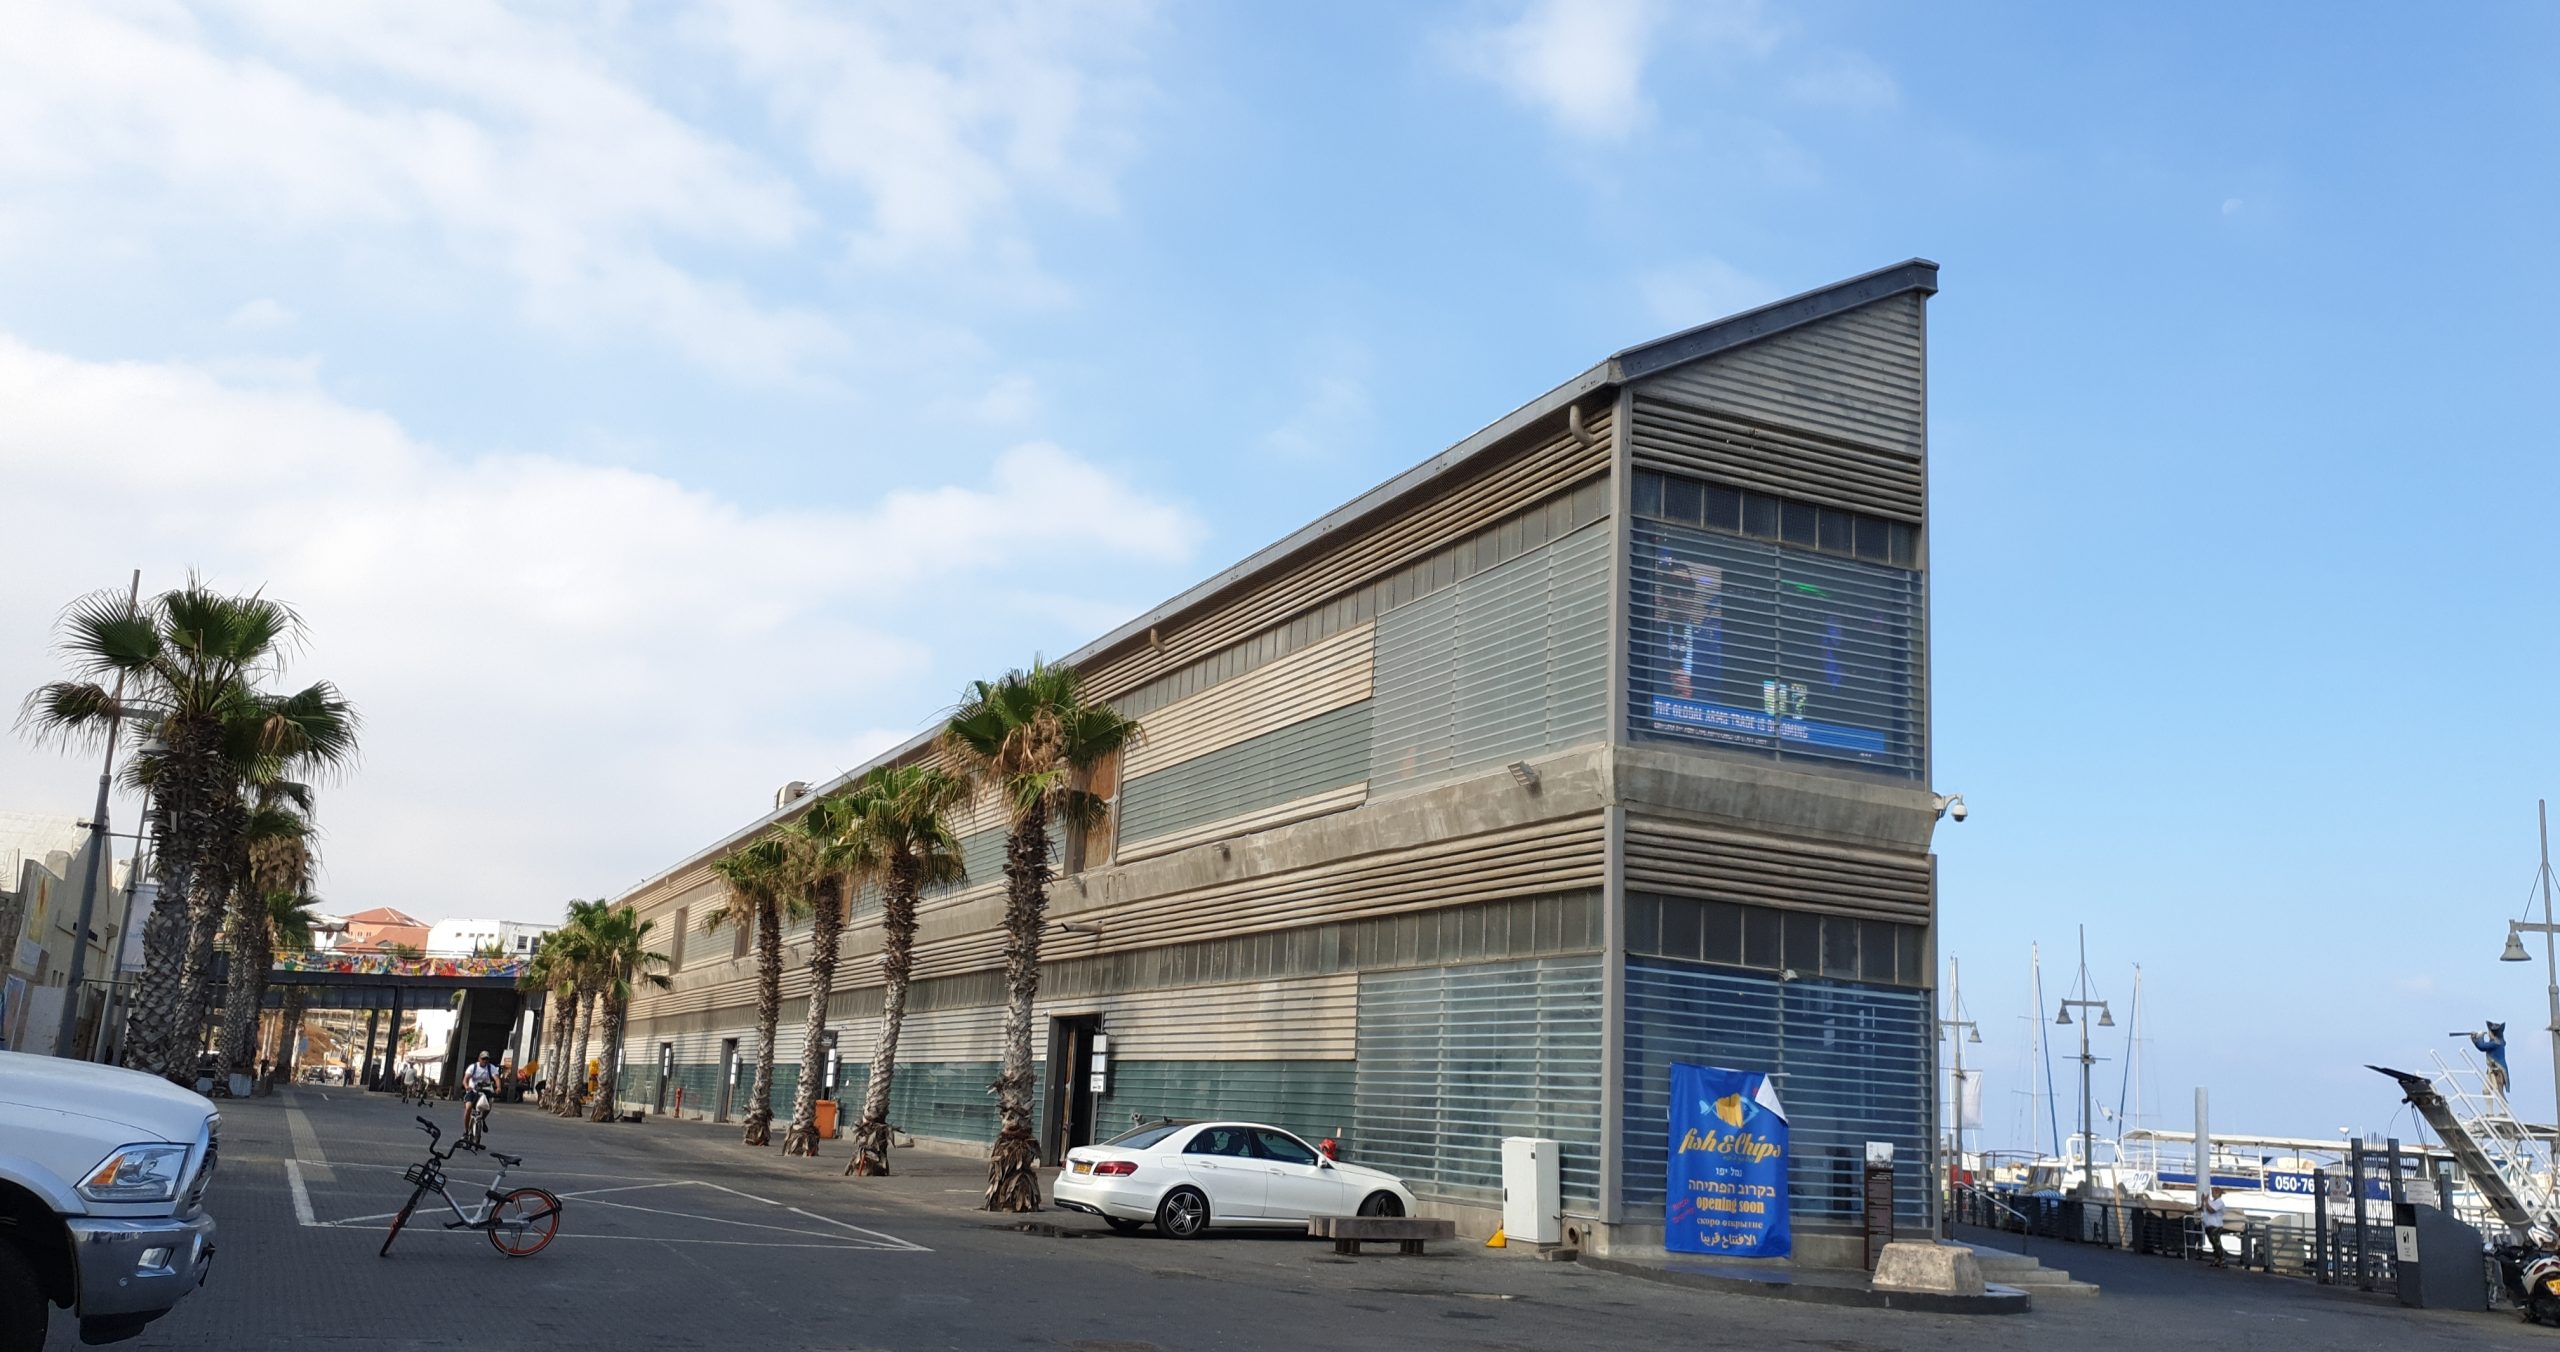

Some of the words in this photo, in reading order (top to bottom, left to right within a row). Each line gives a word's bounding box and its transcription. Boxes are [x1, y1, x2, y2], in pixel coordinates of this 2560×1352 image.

[1688, 1179, 1736, 1194] הפתיחה
[1738, 1183, 1777, 1199] בקרוב
[1696, 1196, 1737, 1214] opening
[1738, 1200, 1765, 1215] soon
